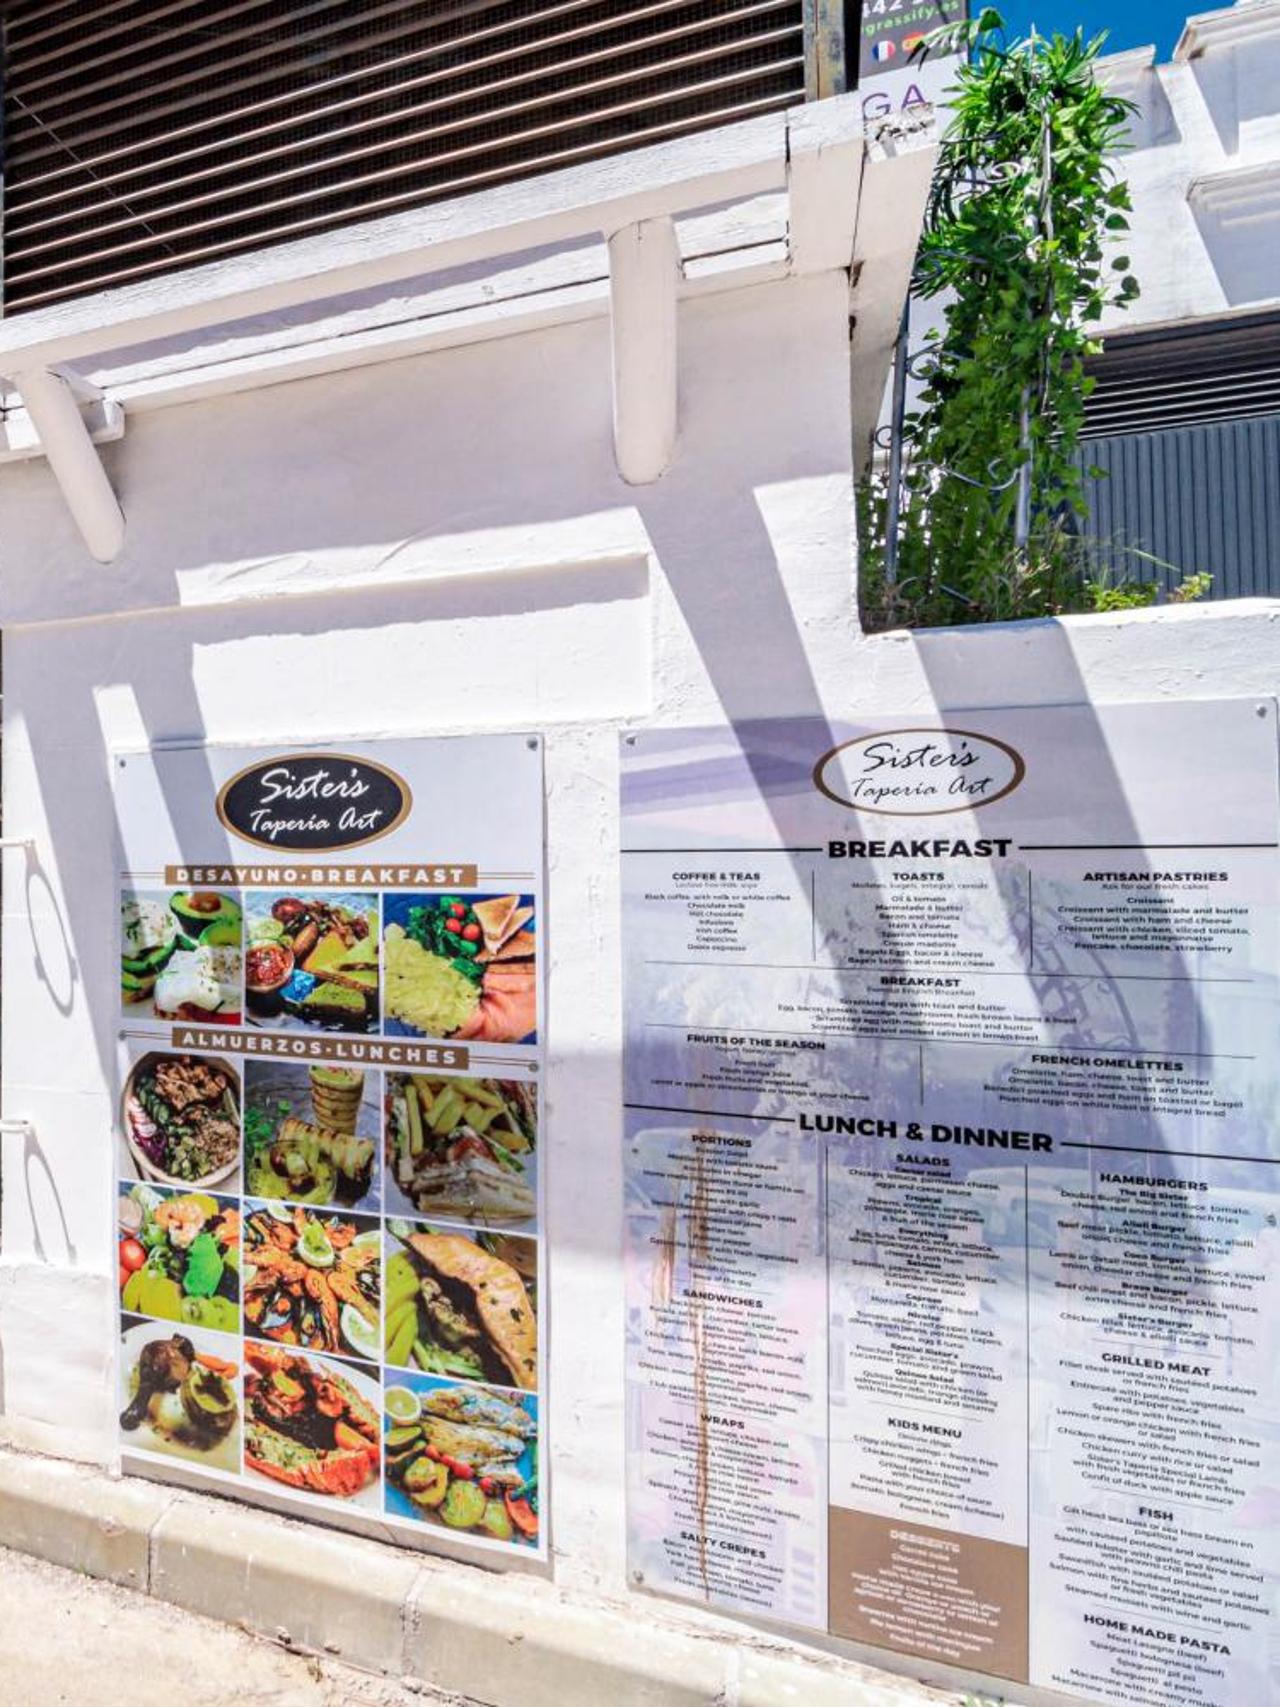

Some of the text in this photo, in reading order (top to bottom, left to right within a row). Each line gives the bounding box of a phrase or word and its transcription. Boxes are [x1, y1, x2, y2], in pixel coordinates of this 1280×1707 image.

[863, 742, 979, 773] Sister's
[260, 768, 370, 804] Sister's
[949, 775, 993, 795] Art
[339, 807, 382, 831] Art
[829, 839, 1012, 858] BREAKFAST
[893, 873, 944, 881] TOASTS
[1083, 873, 1228, 881] ARTISAN PASTRIES
[880, 978, 960, 987] BREAKFAST
[687, 1035, 825, 1049] FRUITS OF THE SEASON
[1032, 1056, 1183, 1071] FRENCH OMELETTES
[692, 1135, 752, 1147] PORTIONS
[800, 1114, 1053, 1152] LUNCH & DINNER
[897, 1155, 950, 1166] SALADS
[1100, 1173, 1208, 1191] HAMBURGERS
[683, 1289, 763, 1308] SANDWICHES
[1102, 1353, 1211, 1376] GRILLED MEAT
[701, 1414, 745, 1429] WRAPS
[888, 1418, 962, 1438] KIDS MENU
[1139, 1507, 1174, 1521] FISH
[681, 1531, 766, 1557] SALTY CREPES
[1084, 1614, 1231, 1654] HOME MADE PASTA
